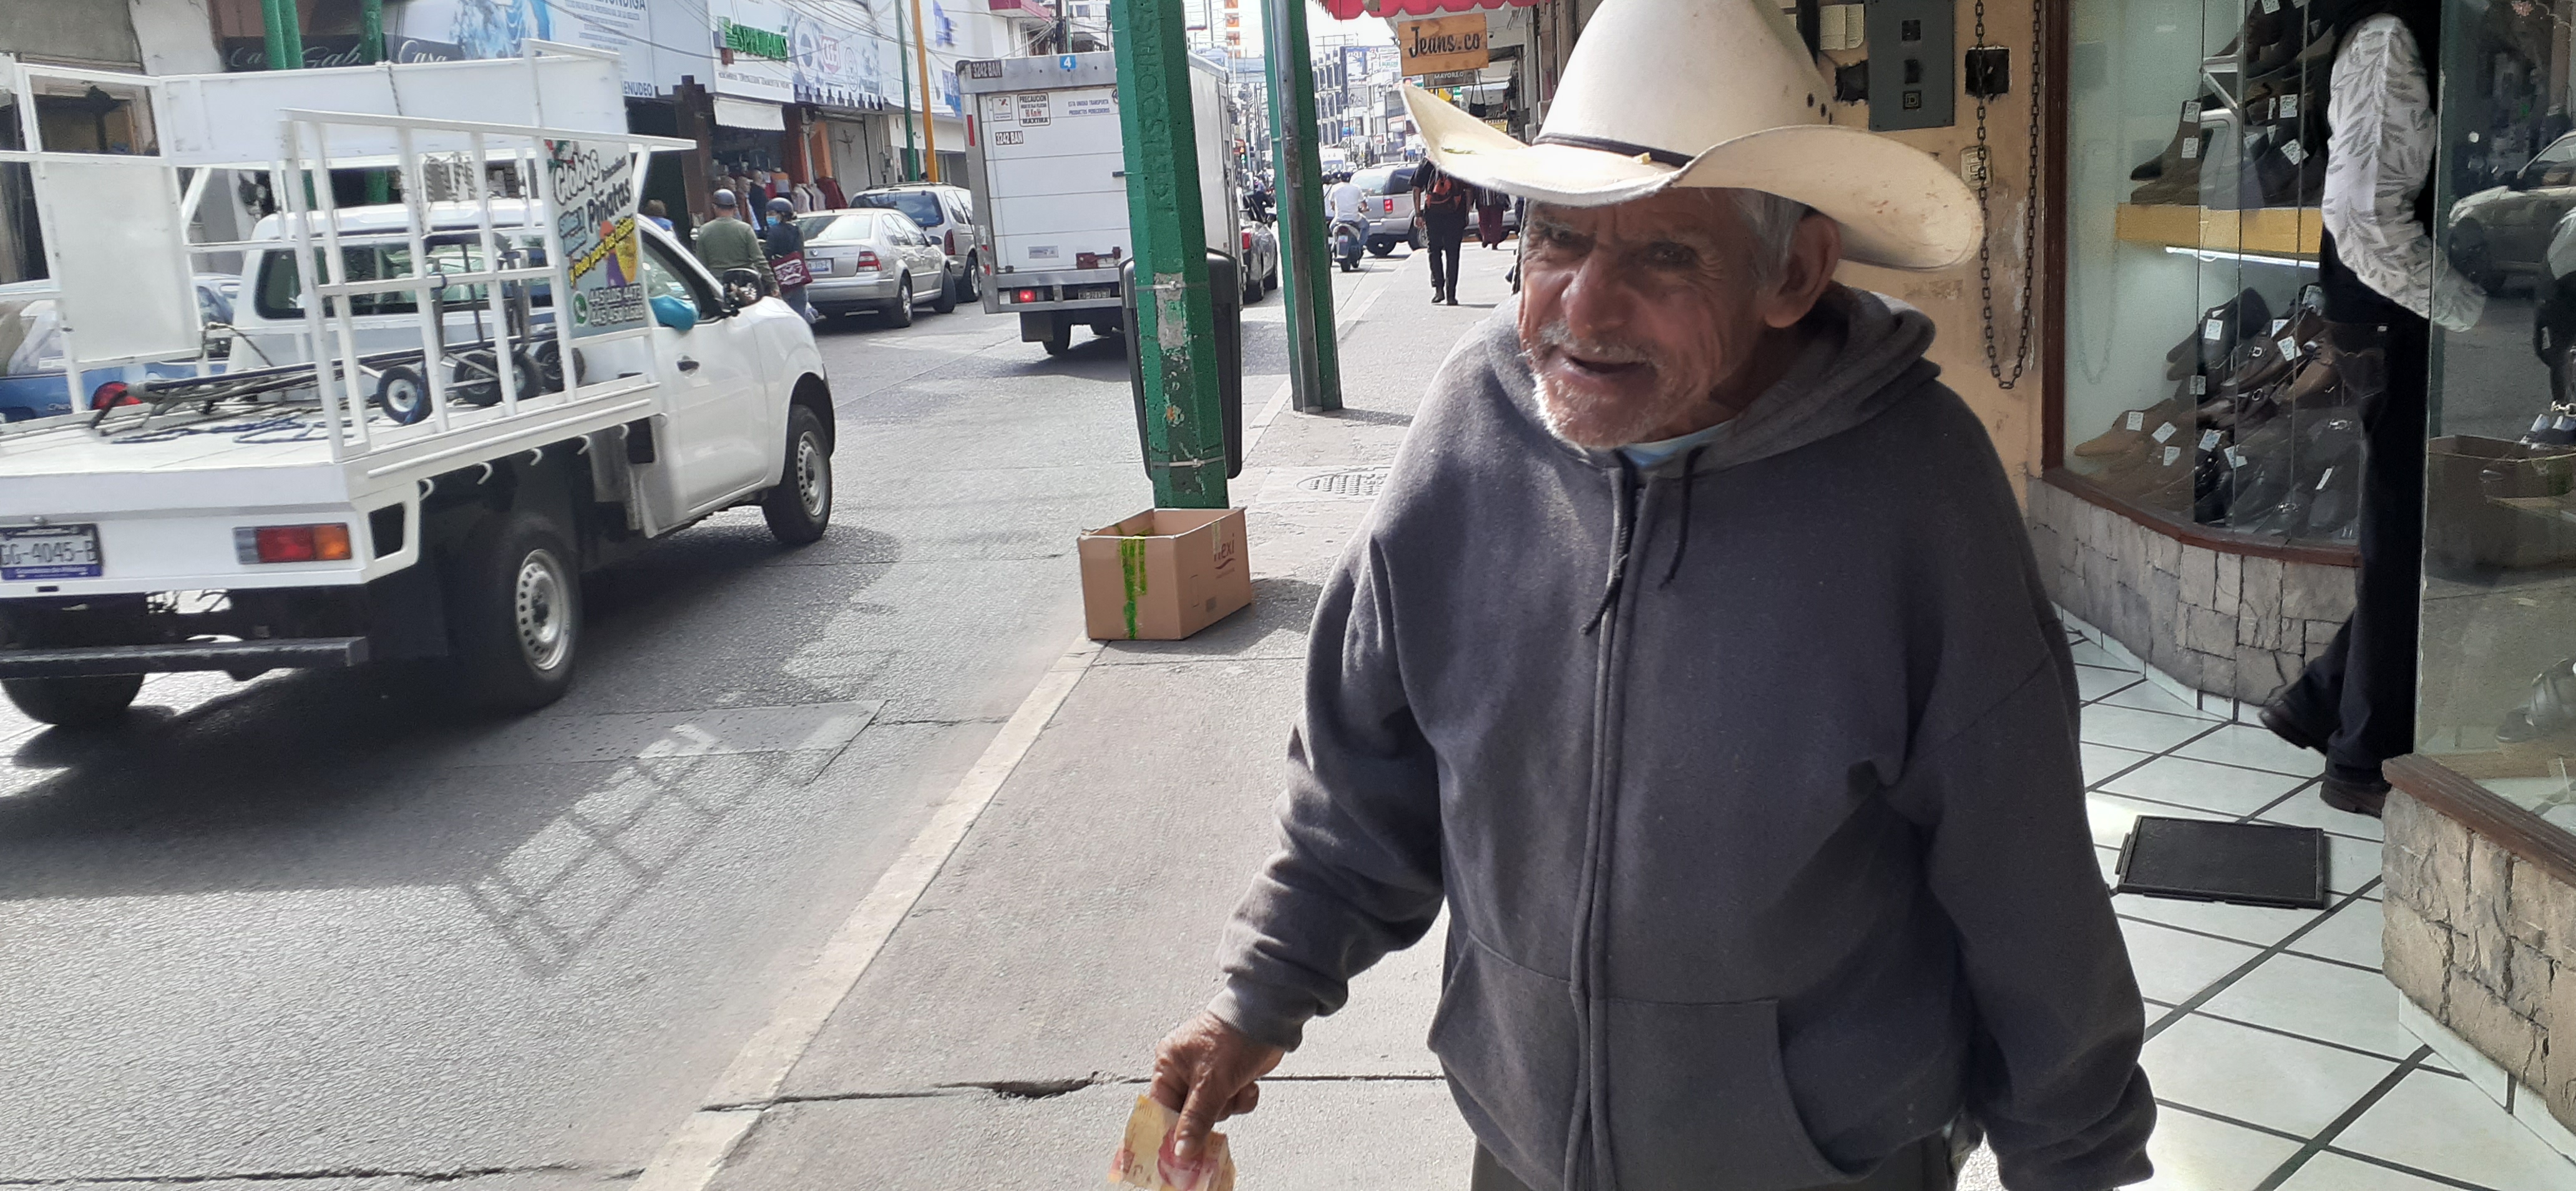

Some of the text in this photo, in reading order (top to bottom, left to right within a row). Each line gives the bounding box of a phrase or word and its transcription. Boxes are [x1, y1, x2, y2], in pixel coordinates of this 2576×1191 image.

[1408, 26, 1483, 58] Jeans.co
[972, 62, 1001, 77] 3242 BAN
[1063, 56, 1071, 68] 4
[622, 81, 653, 97] ENUDEO
[996, 132, 1023, 144] 3242 BAN
[554, 149, 600, 206] Globos
[587, 178, 630, 233] Piñatas
